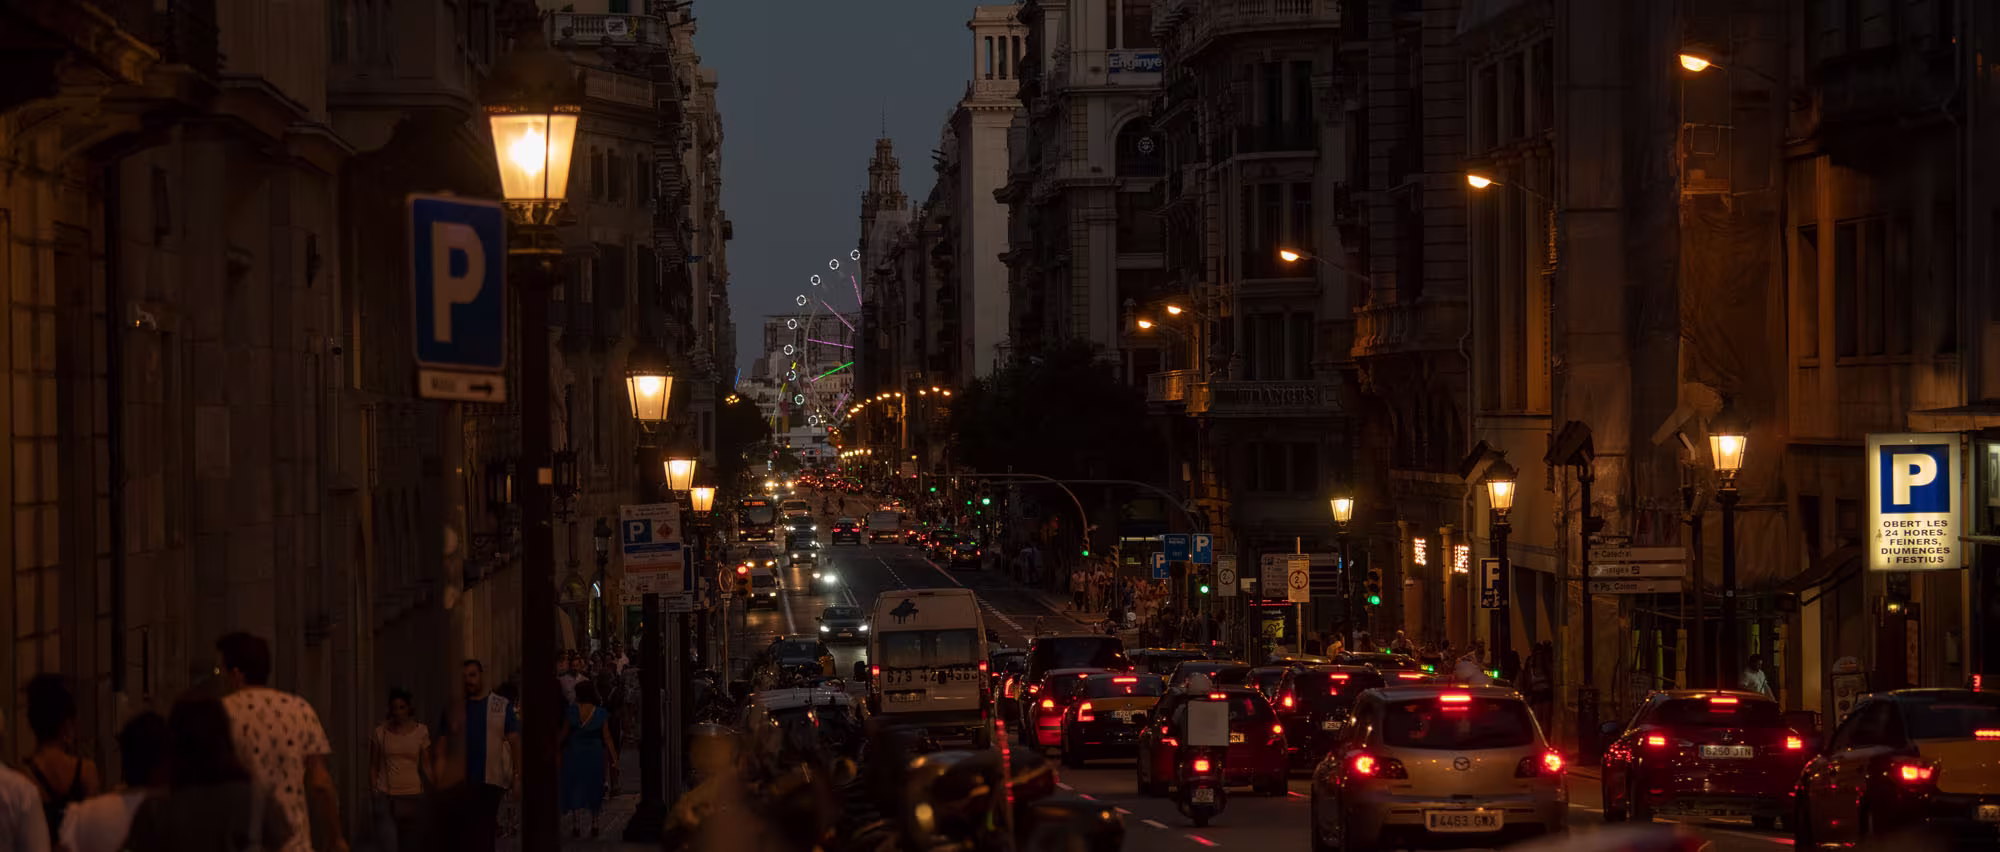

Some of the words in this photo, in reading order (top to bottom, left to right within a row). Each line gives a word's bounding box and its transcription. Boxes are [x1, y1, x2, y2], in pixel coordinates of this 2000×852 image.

[431, 221, 486, 344] P
[1891, 453, 1938, 505] P
[630, 521, 646, 542] P
[1883, 520, 1921, 528] OBERT
[1927, 519, 1948, 527] LES
[1196, 535, 1210, 552] P
[1890, 538, 1941, 546] FEINERS,
[1881, 547, 1950, 555] DIUMENGES
[1156, 553, 1166, 568] P
